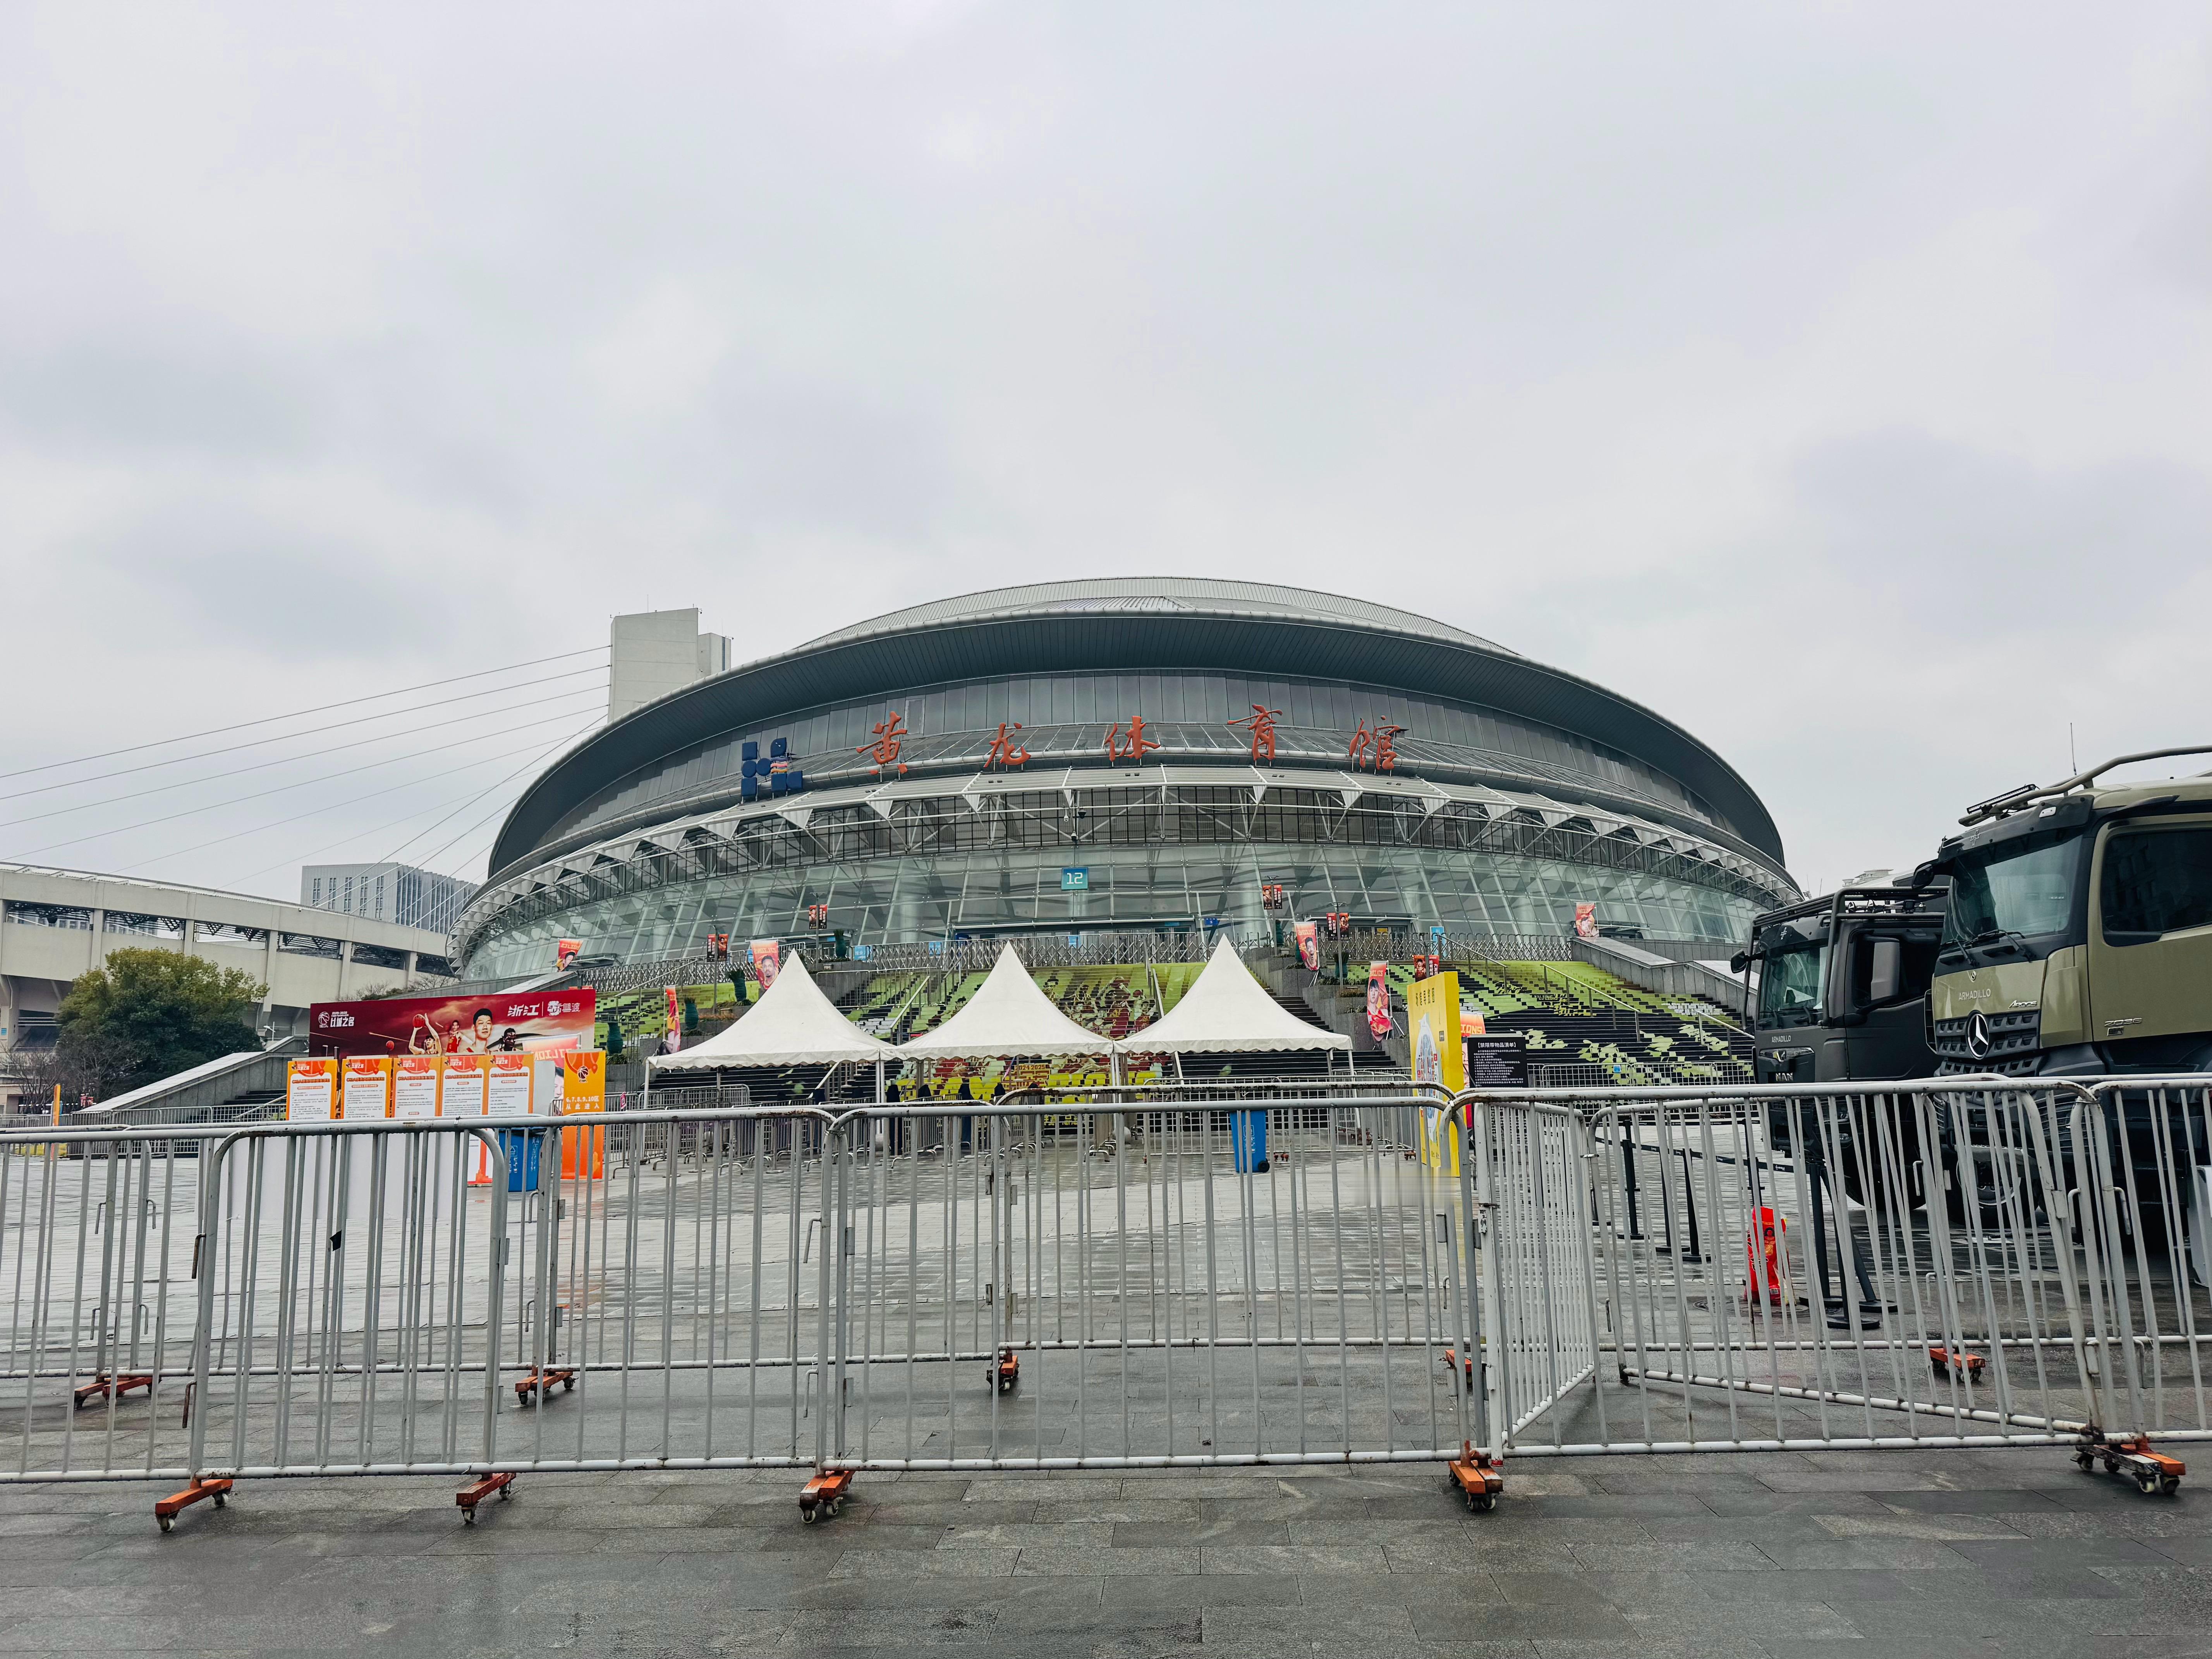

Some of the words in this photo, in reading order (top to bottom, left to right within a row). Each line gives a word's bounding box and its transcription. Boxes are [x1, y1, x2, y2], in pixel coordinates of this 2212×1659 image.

[855, 704, 1401, 775] 黄龙体育馆
[1066, 872, 1083, 884] 12
[1959, 989, 1991, 1001] ARMADILLO
[507, 1003, 540, 1016] 浙江
